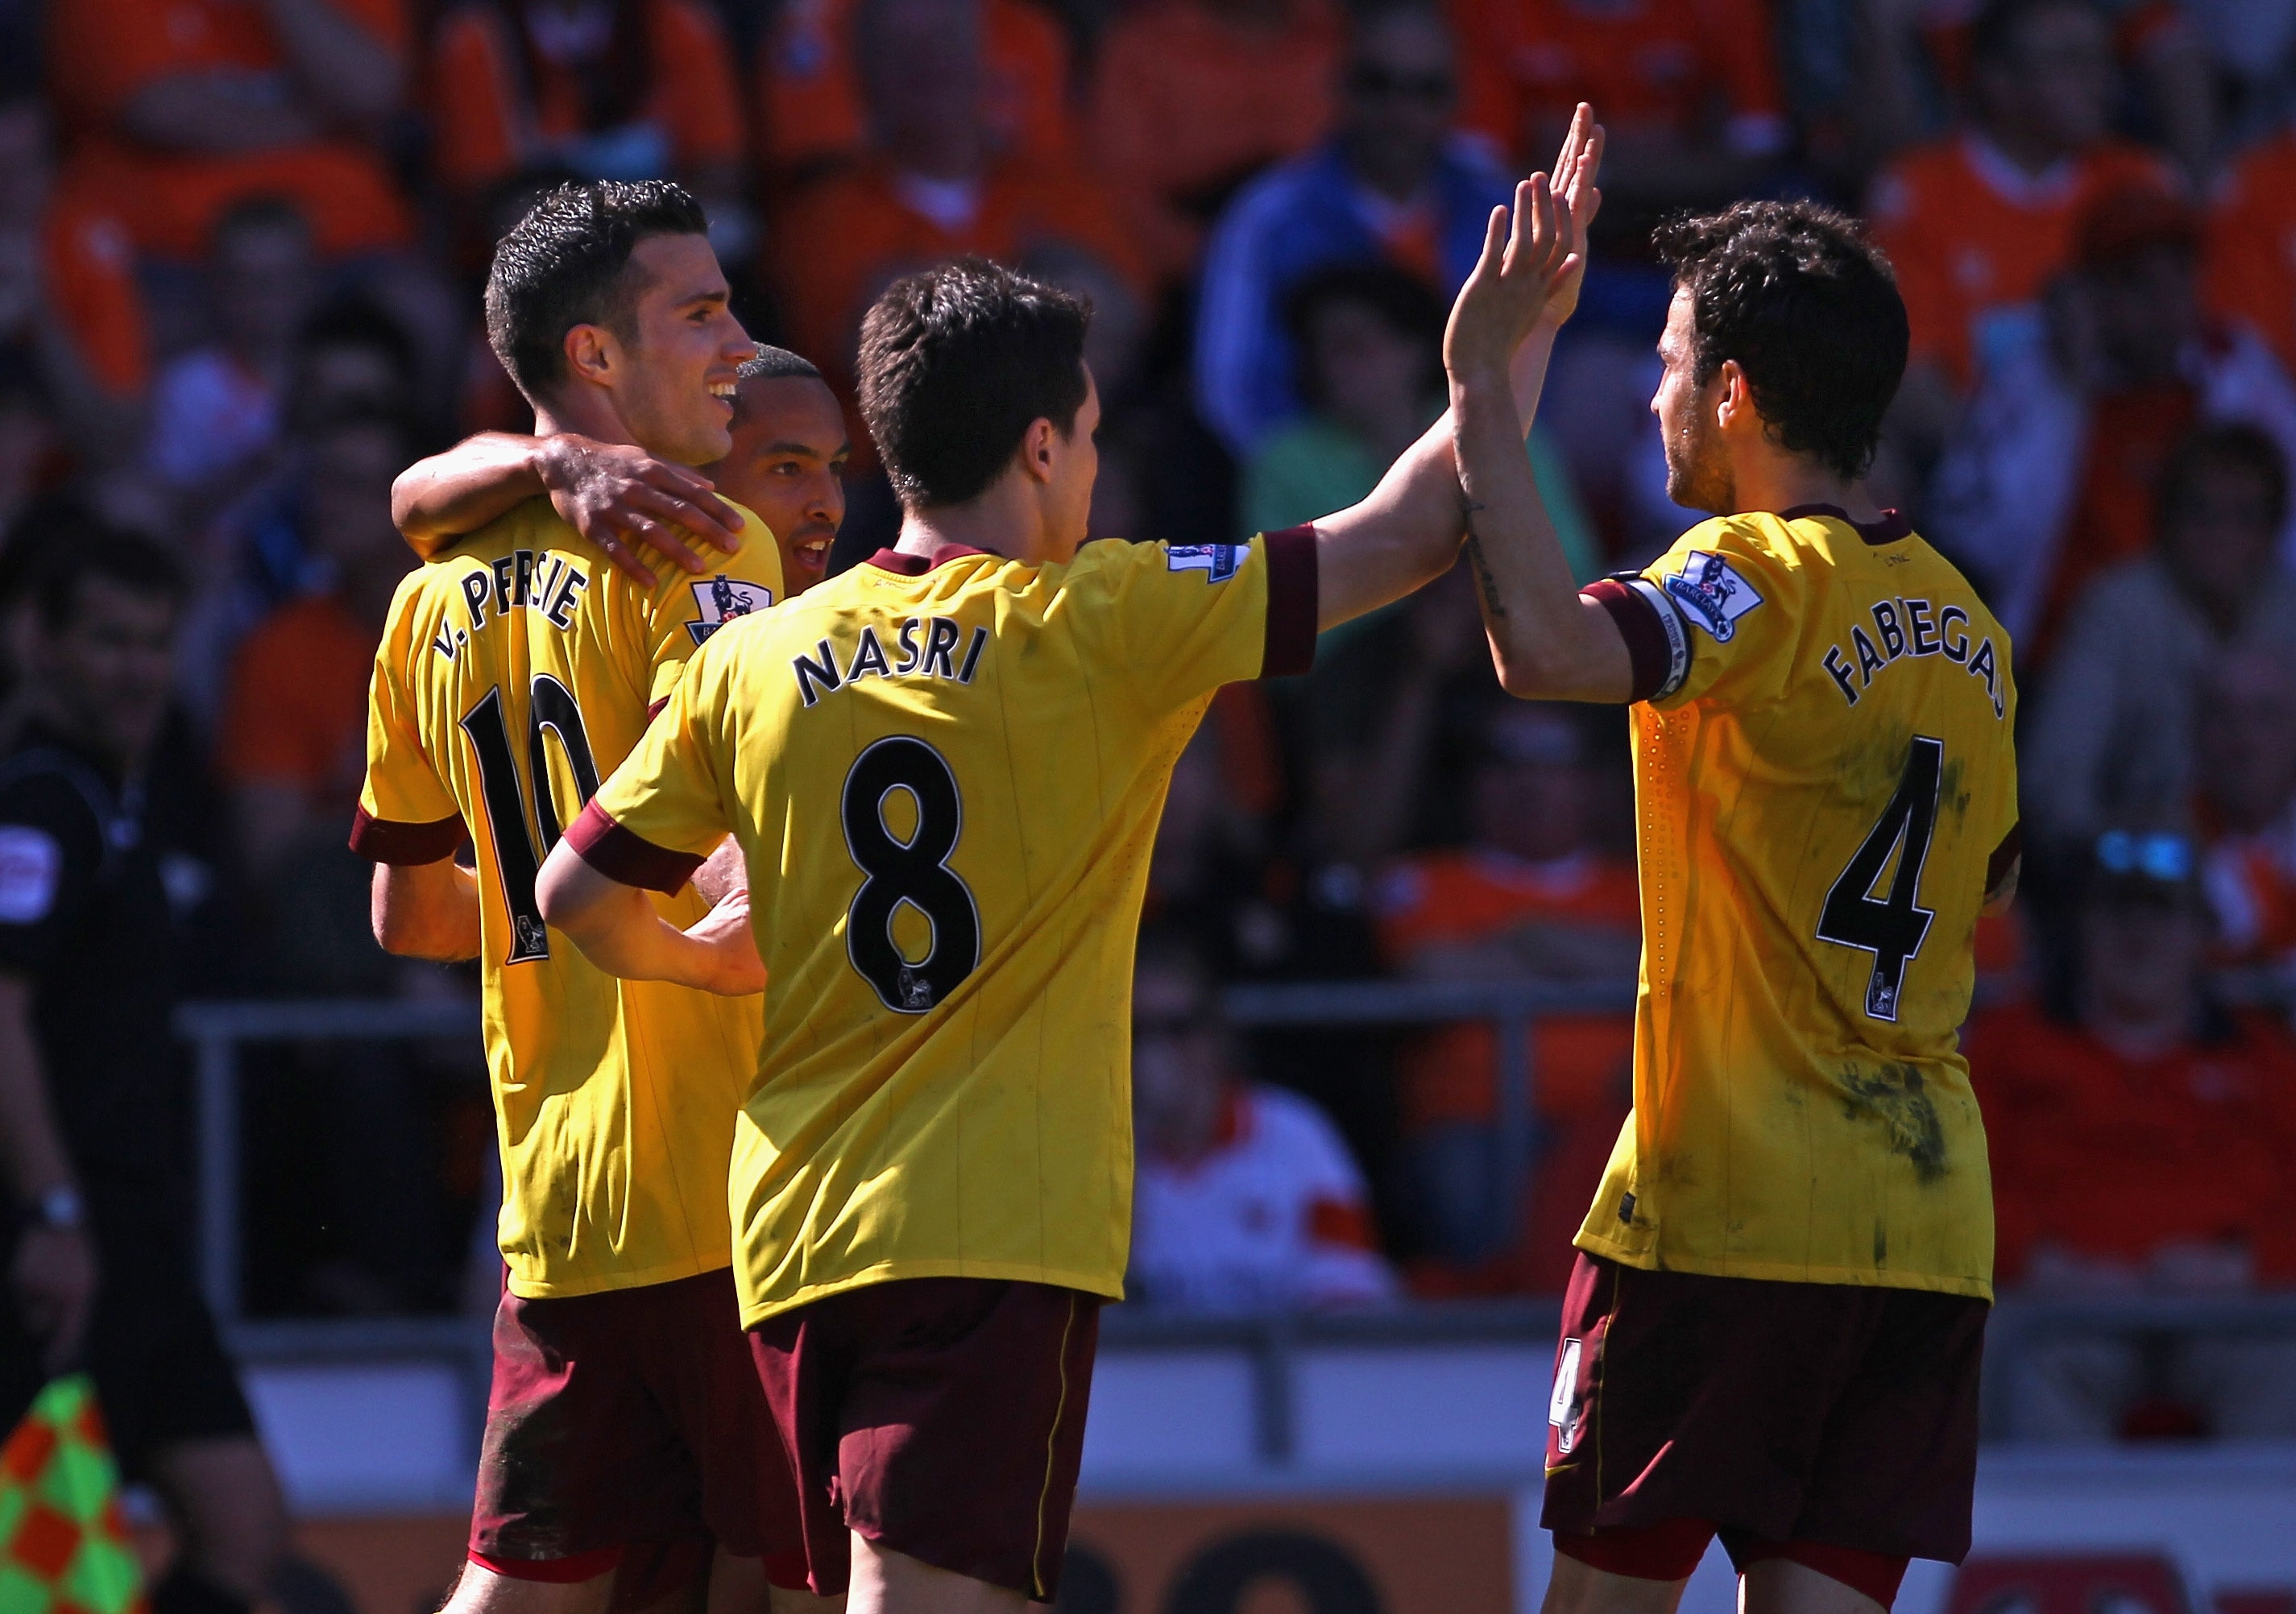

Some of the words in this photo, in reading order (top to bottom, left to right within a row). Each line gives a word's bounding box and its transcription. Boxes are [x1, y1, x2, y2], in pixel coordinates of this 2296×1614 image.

[791, 616, 989, 708] NASRI
[841, 734, 982, 1016] 8
[1816, 735, 1943, 1022] 4
[1548, 1337, 1582, 1455] 4
